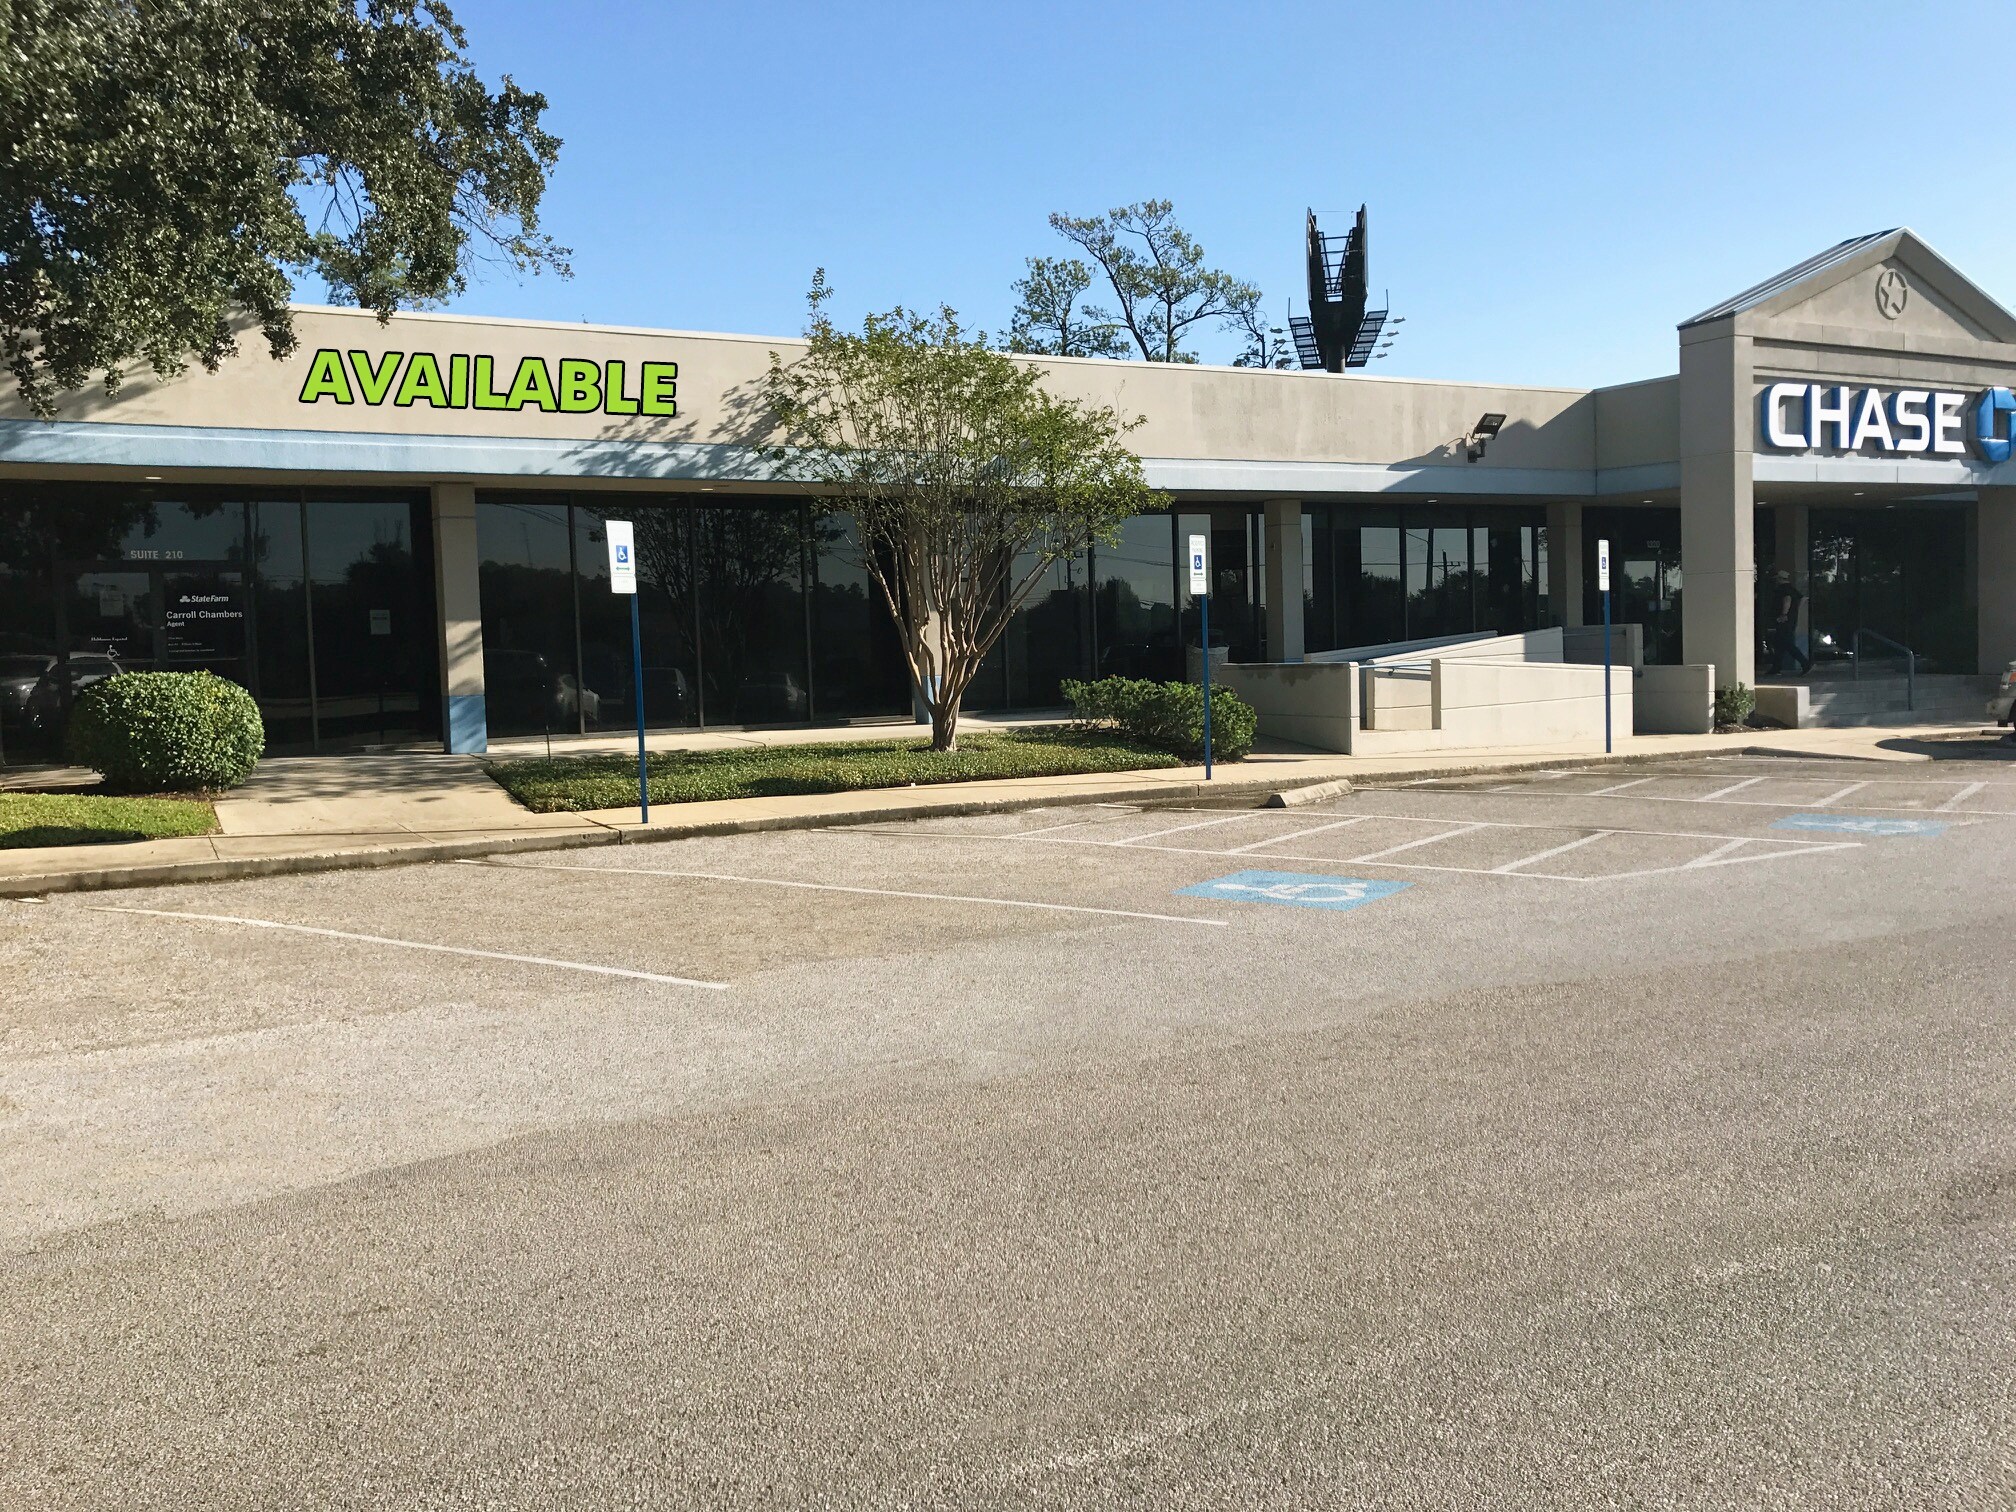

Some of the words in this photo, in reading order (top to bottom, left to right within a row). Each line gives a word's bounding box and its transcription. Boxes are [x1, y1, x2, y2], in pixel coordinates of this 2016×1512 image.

[300, 348, 678, 417] AVAILABLE
[1765, 382, 1966, 454] CHASE
[130, 550, 159, 559] SUITE
[165, 550, 183, 559] 210
[166, 611, 197, 619] Carroll
[199, 610, 243, 619] Chambers
